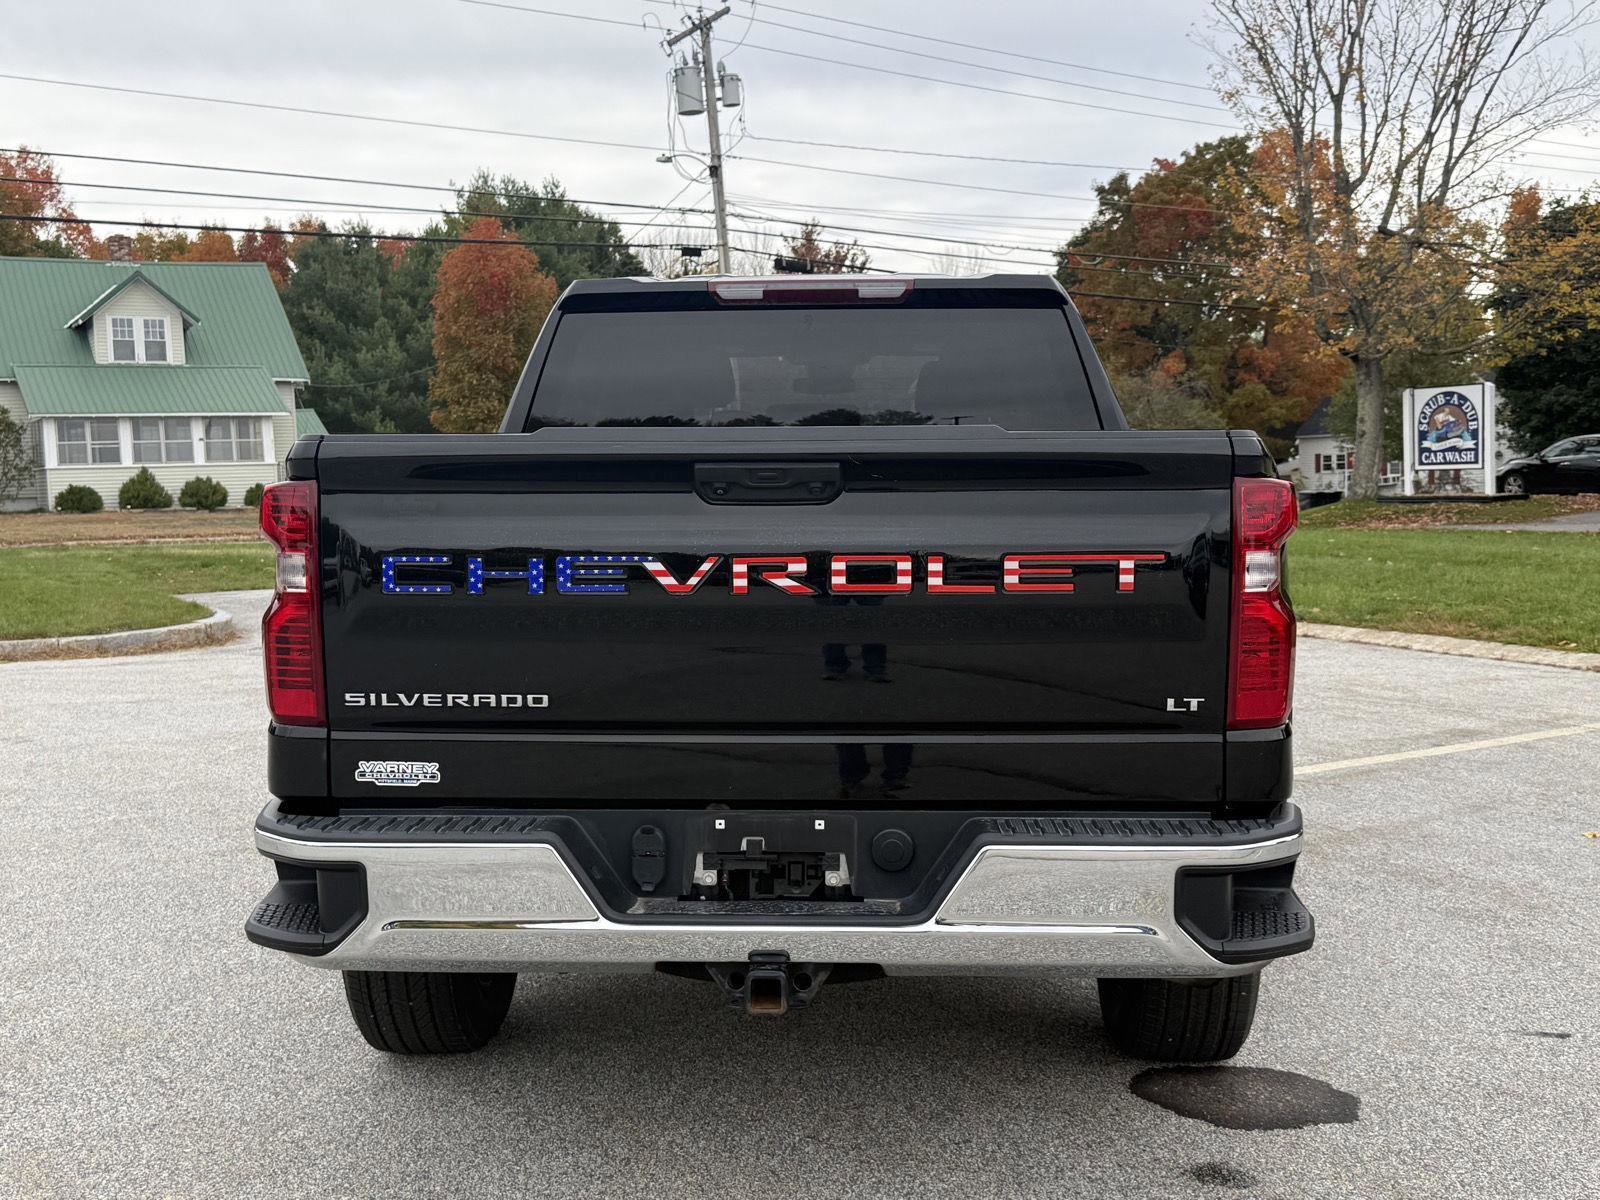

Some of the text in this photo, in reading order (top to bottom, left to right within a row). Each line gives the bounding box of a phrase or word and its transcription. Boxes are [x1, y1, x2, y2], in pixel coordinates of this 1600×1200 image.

[1418, 393, 1478, 431] SCRUB-A-DUB
[1421, 451, 1475, 463] CAR WASH
[381, 552, 1166, 596] CHEVROLET
[344, 693, 549, 707] SILVERADO
[1166, 697, 1205, 711] LT
[360, 763, 438, 773] VARNEY
